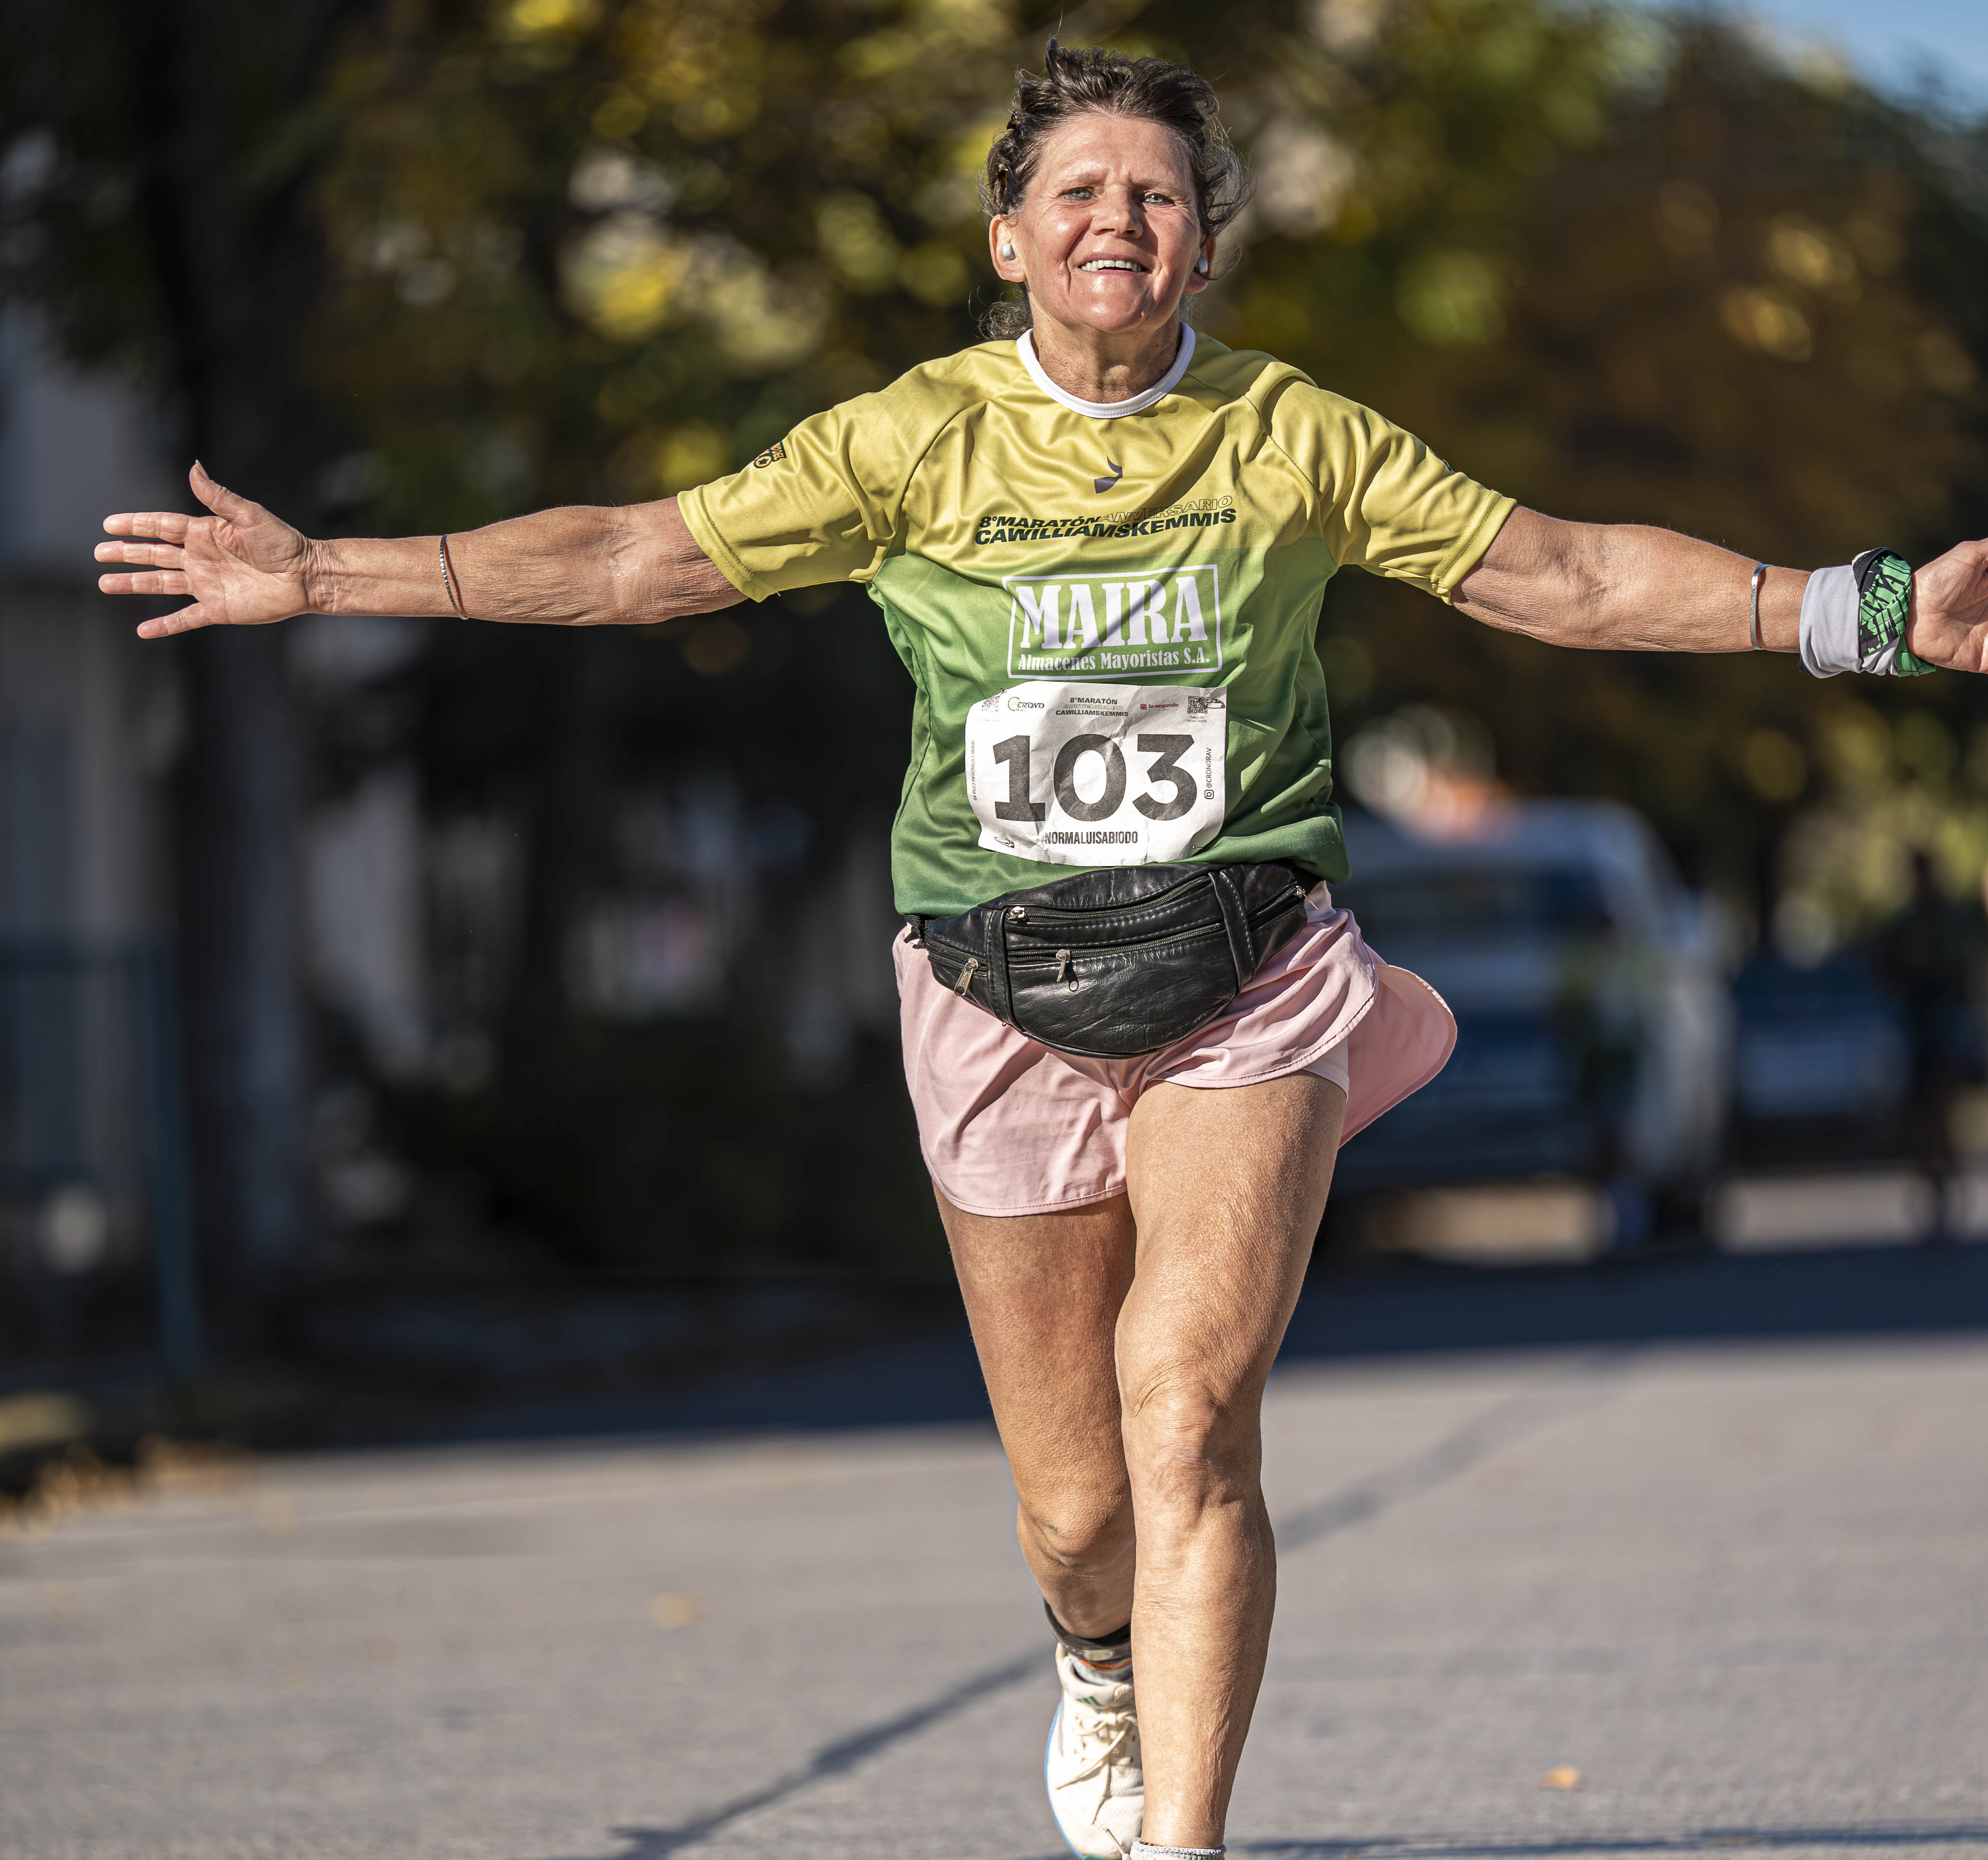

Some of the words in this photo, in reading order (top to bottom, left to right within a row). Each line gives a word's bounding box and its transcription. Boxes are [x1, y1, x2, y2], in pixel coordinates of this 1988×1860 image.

[1099, 495, 1233, 523] ANIVERSARIO
[975, 508, 1237, 545] CAWILLIAMSKEMMIS
[1015, 576, 1208, 649] MAIRA
[1018, 654, 1096, 671] Almacenes
[1100, 650, 1179, 670] Mayoristas
[1184, 647, 1210, 665] S.A.
[992, 733, 1198, 822] 103
[1045, 831, 1138, 844] NORMALUISABIODO
